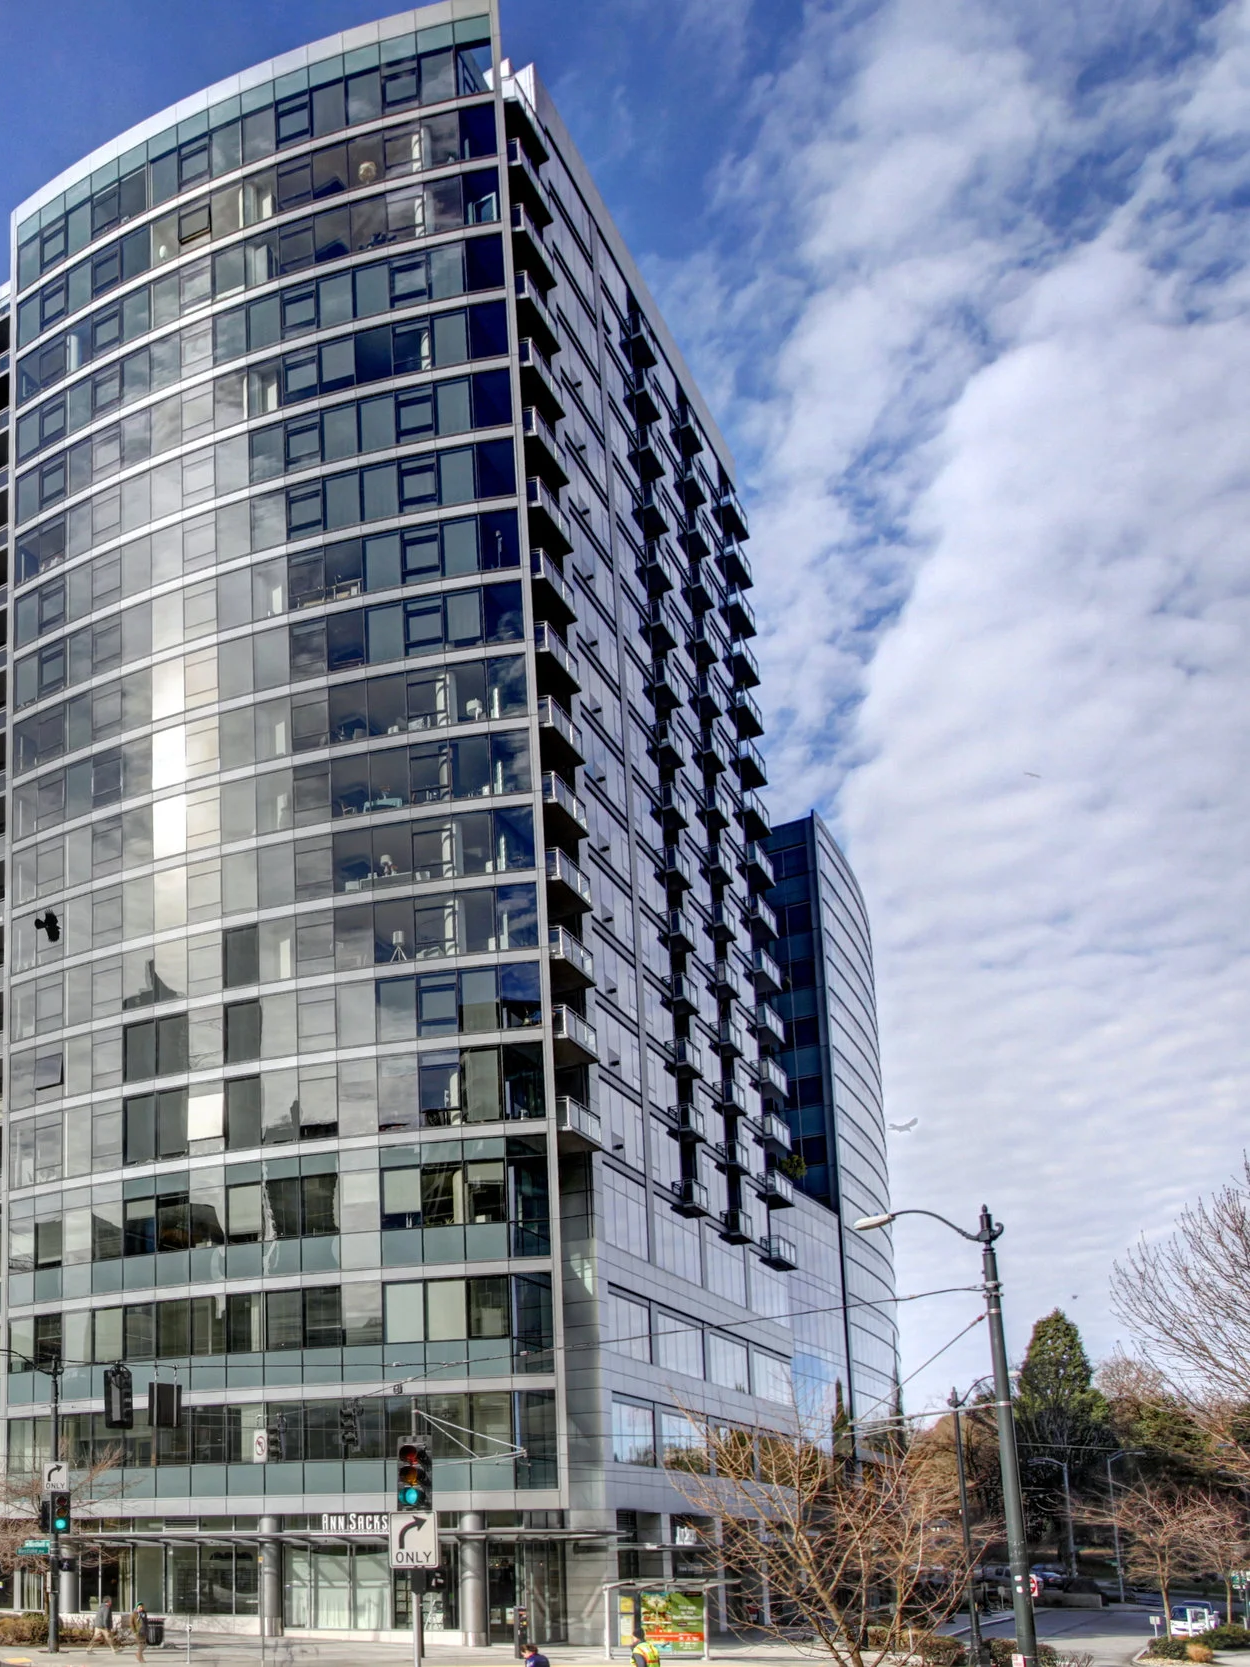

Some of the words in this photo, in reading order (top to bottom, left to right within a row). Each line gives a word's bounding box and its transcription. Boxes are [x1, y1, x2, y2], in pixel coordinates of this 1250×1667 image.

[45, 1482, 66, 1490] ONLY
[321, 1513, 346, 1531] ANN
[349, 1513, 389, 1531] SACKS
[395, 1551, 432, 1564] ONLY
